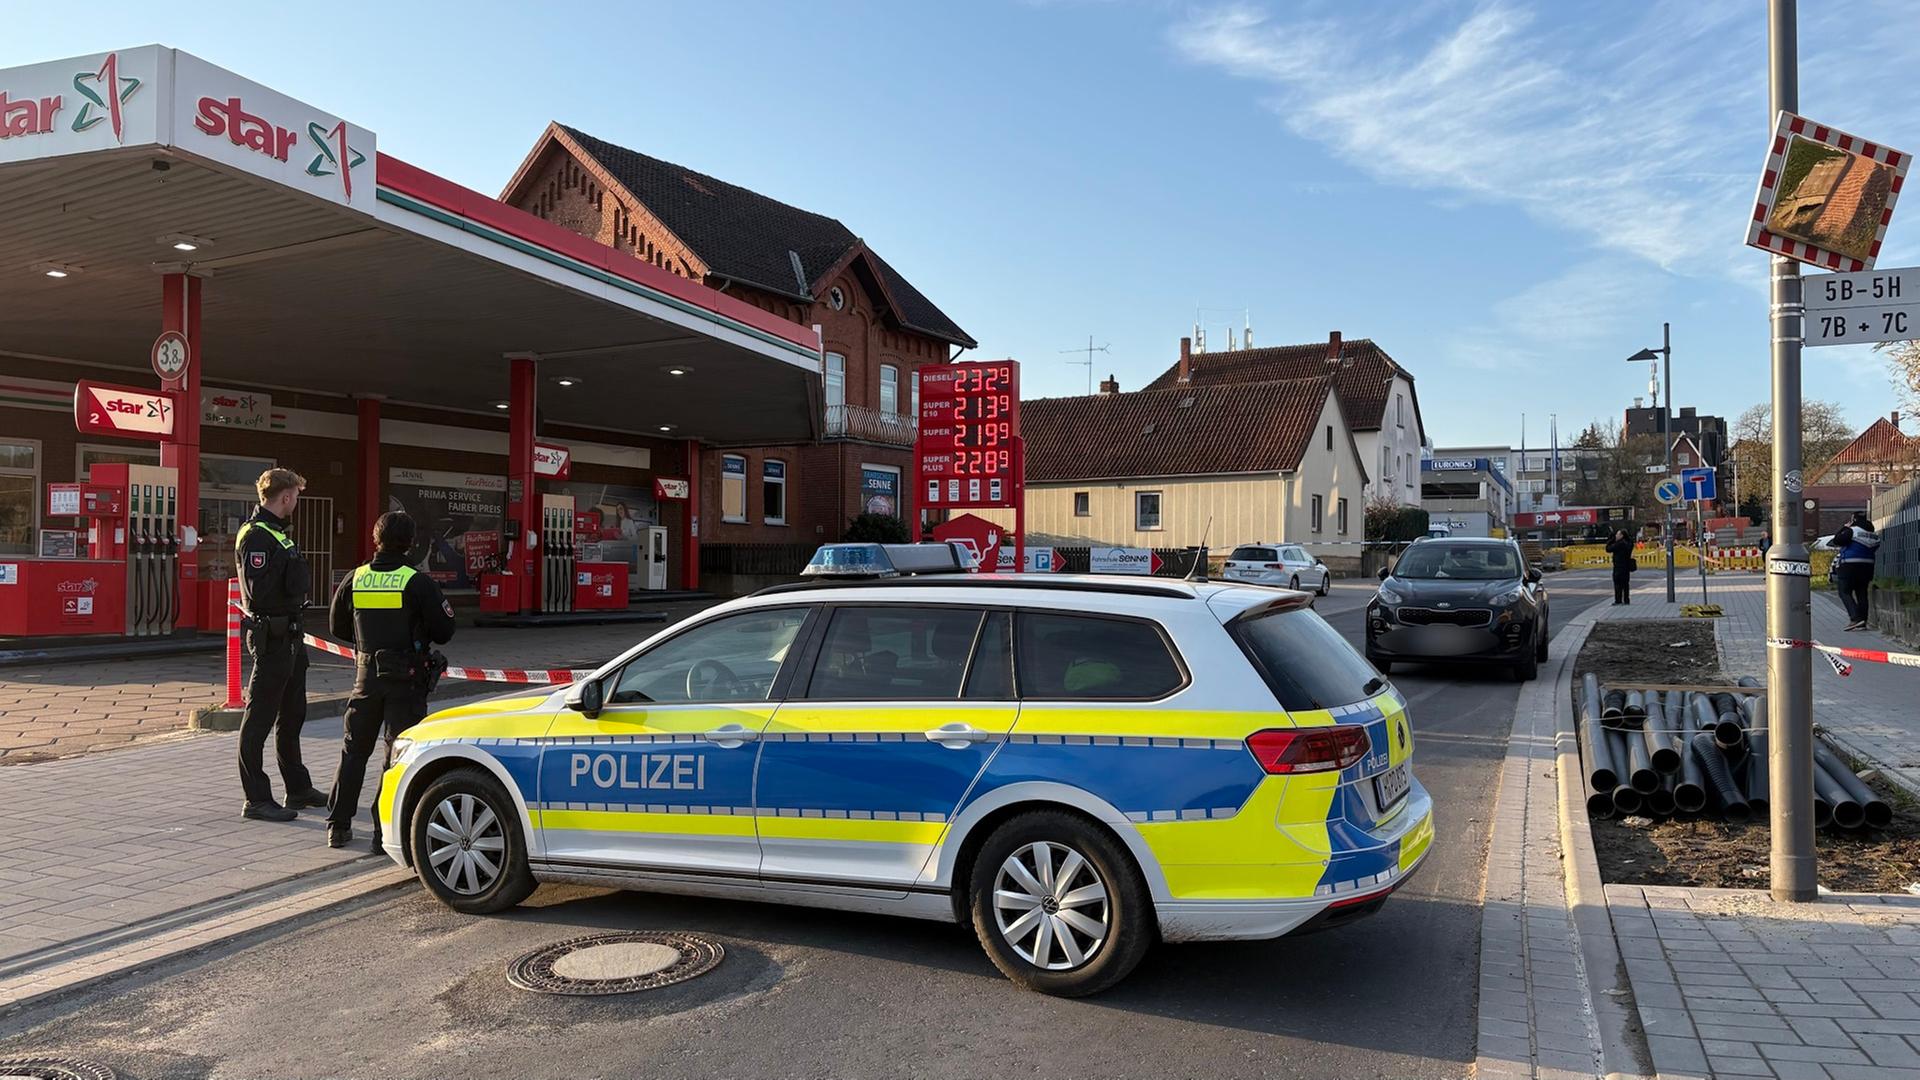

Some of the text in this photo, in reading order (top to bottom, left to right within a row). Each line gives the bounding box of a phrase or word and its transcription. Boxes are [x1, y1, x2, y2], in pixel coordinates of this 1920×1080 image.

[0, 91, 63, 139] tar
[194, 97, 297, 163] star
[1821, 316, 1846, 338] 7B
[1882, 312, 1908, 334] 7C
[923, 374, 952, 383] DIESEL
[106, 399, 143, 415] star
[212, 396, 238, 408] star
[89, 412, 100, 424] 2
[922, 464, 944, 472] PLUS
[1434, 460, 1472, 468] EURONICS
[868, 479, 892, 489] SENNE
[418, 489, 481, 502] PRIMA SERVICE
[448, 502, 502, 514] FAIRER PREIS
[355, 573, 405, 588] POLIZEI
[57, 581, 82, 593] star
[570, 753, 705, 790] POLIZEI
